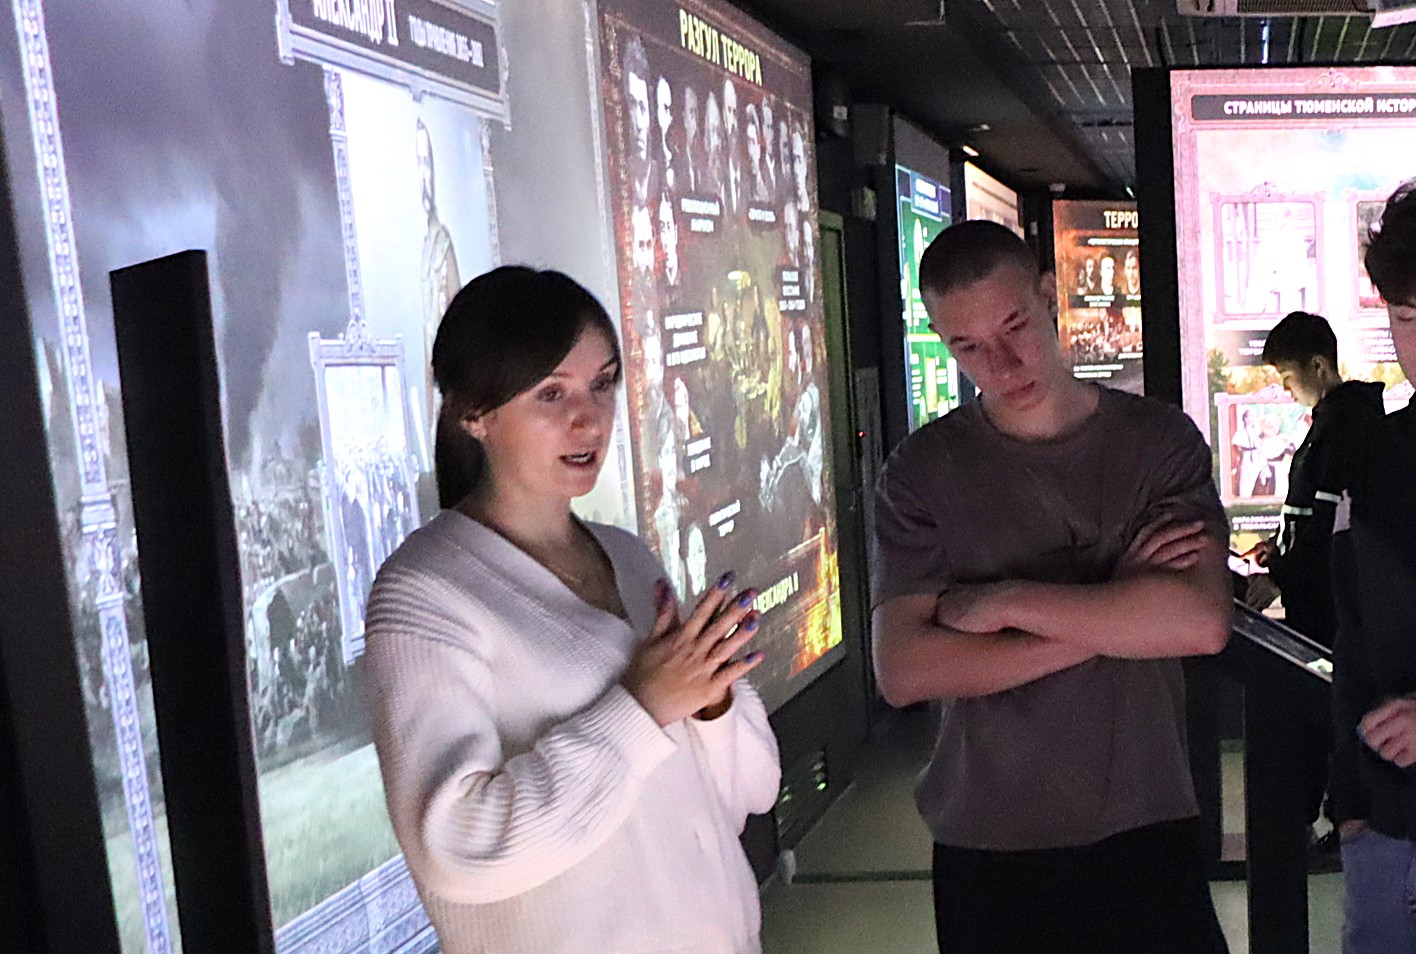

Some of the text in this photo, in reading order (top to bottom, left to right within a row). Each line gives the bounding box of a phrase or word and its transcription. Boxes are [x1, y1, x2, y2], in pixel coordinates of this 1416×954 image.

[679, 8, 763, 87] РАЗГУЛ ТЕРРОРА
[1223, 100, 1293, 115] СТРАНИЦЫ
[1294, 97, 1374, 114] ТЮМЕНСКОЙ
[1103, 210, 1139, 229] ТЕРРО
